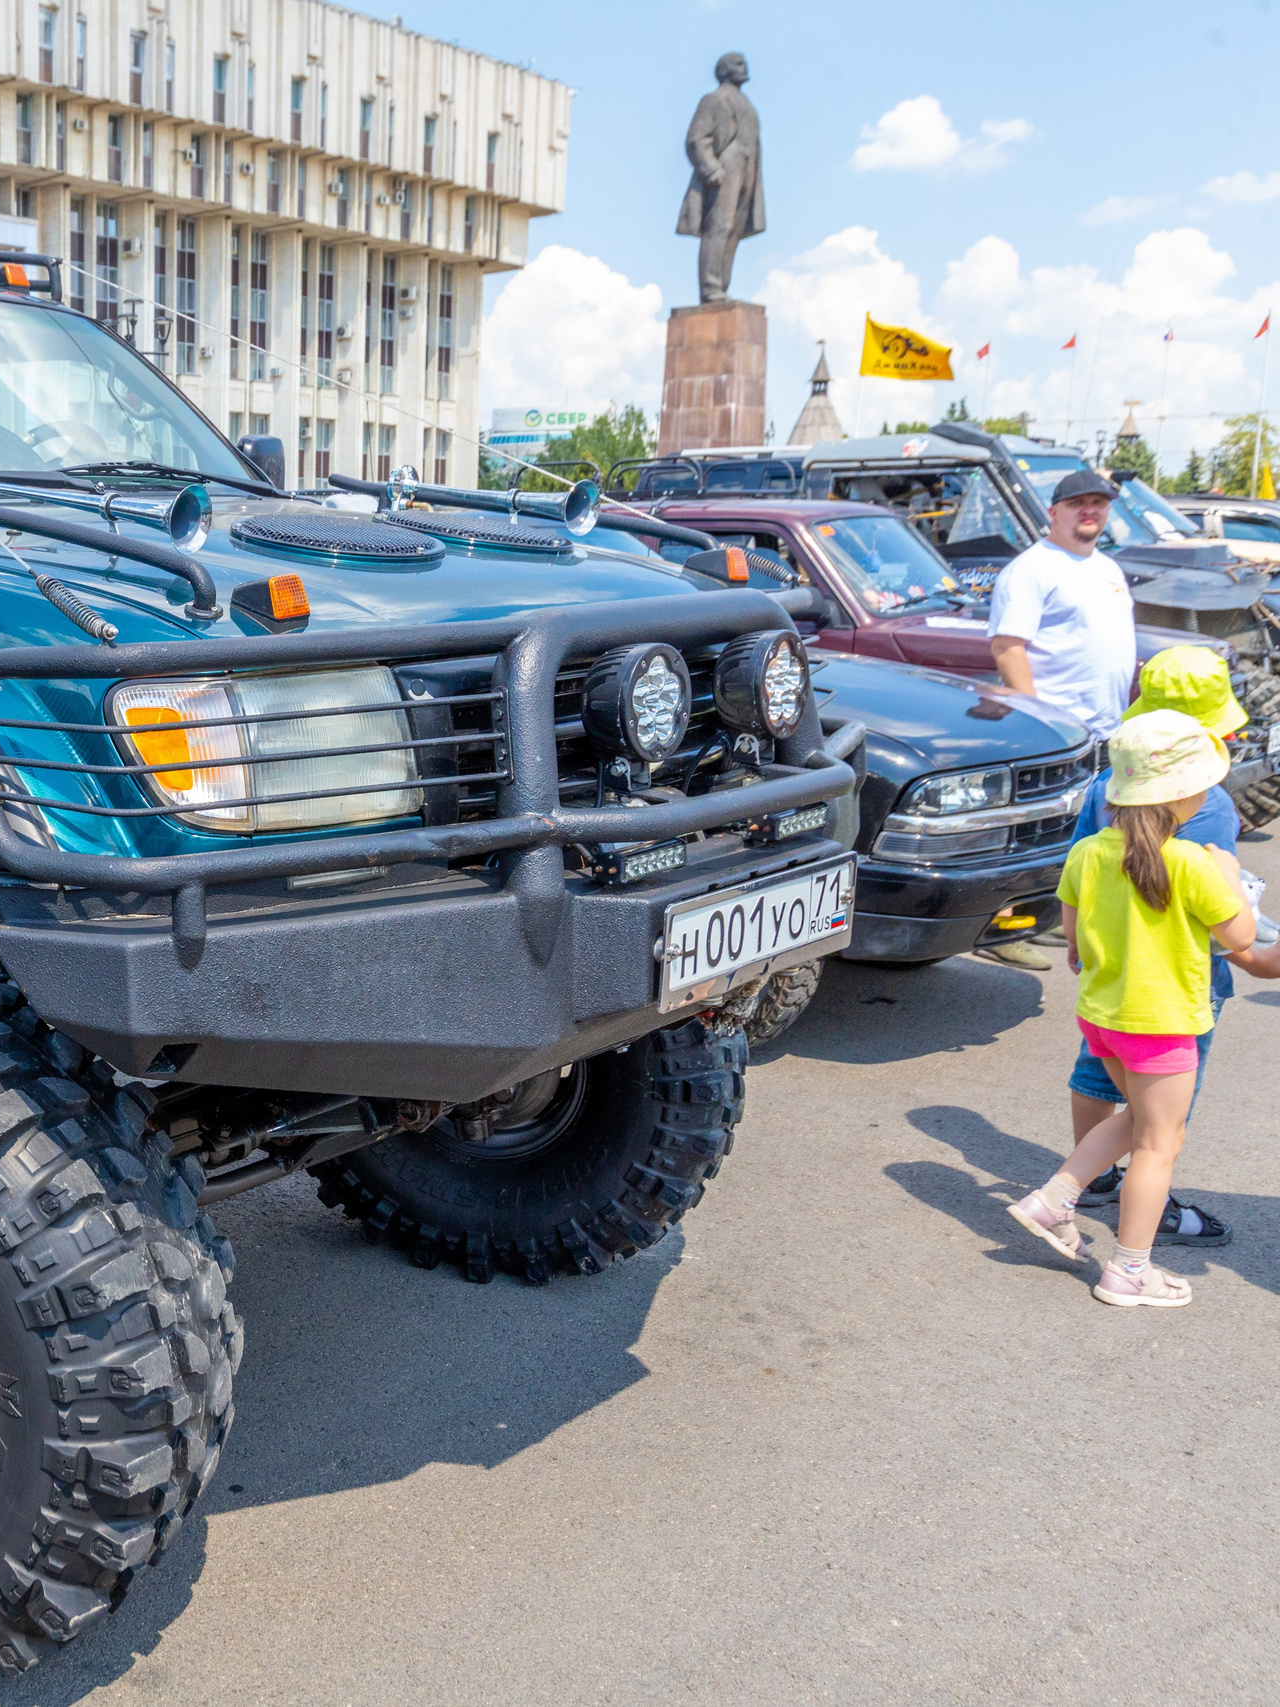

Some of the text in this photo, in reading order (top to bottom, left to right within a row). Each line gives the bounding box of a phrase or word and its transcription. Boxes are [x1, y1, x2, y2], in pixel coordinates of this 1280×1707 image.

[546, 412, 587, 425] СБЕР
[680, 869, 842, 979] Н001УО 71
[810, 915, 831, 936] RUS
